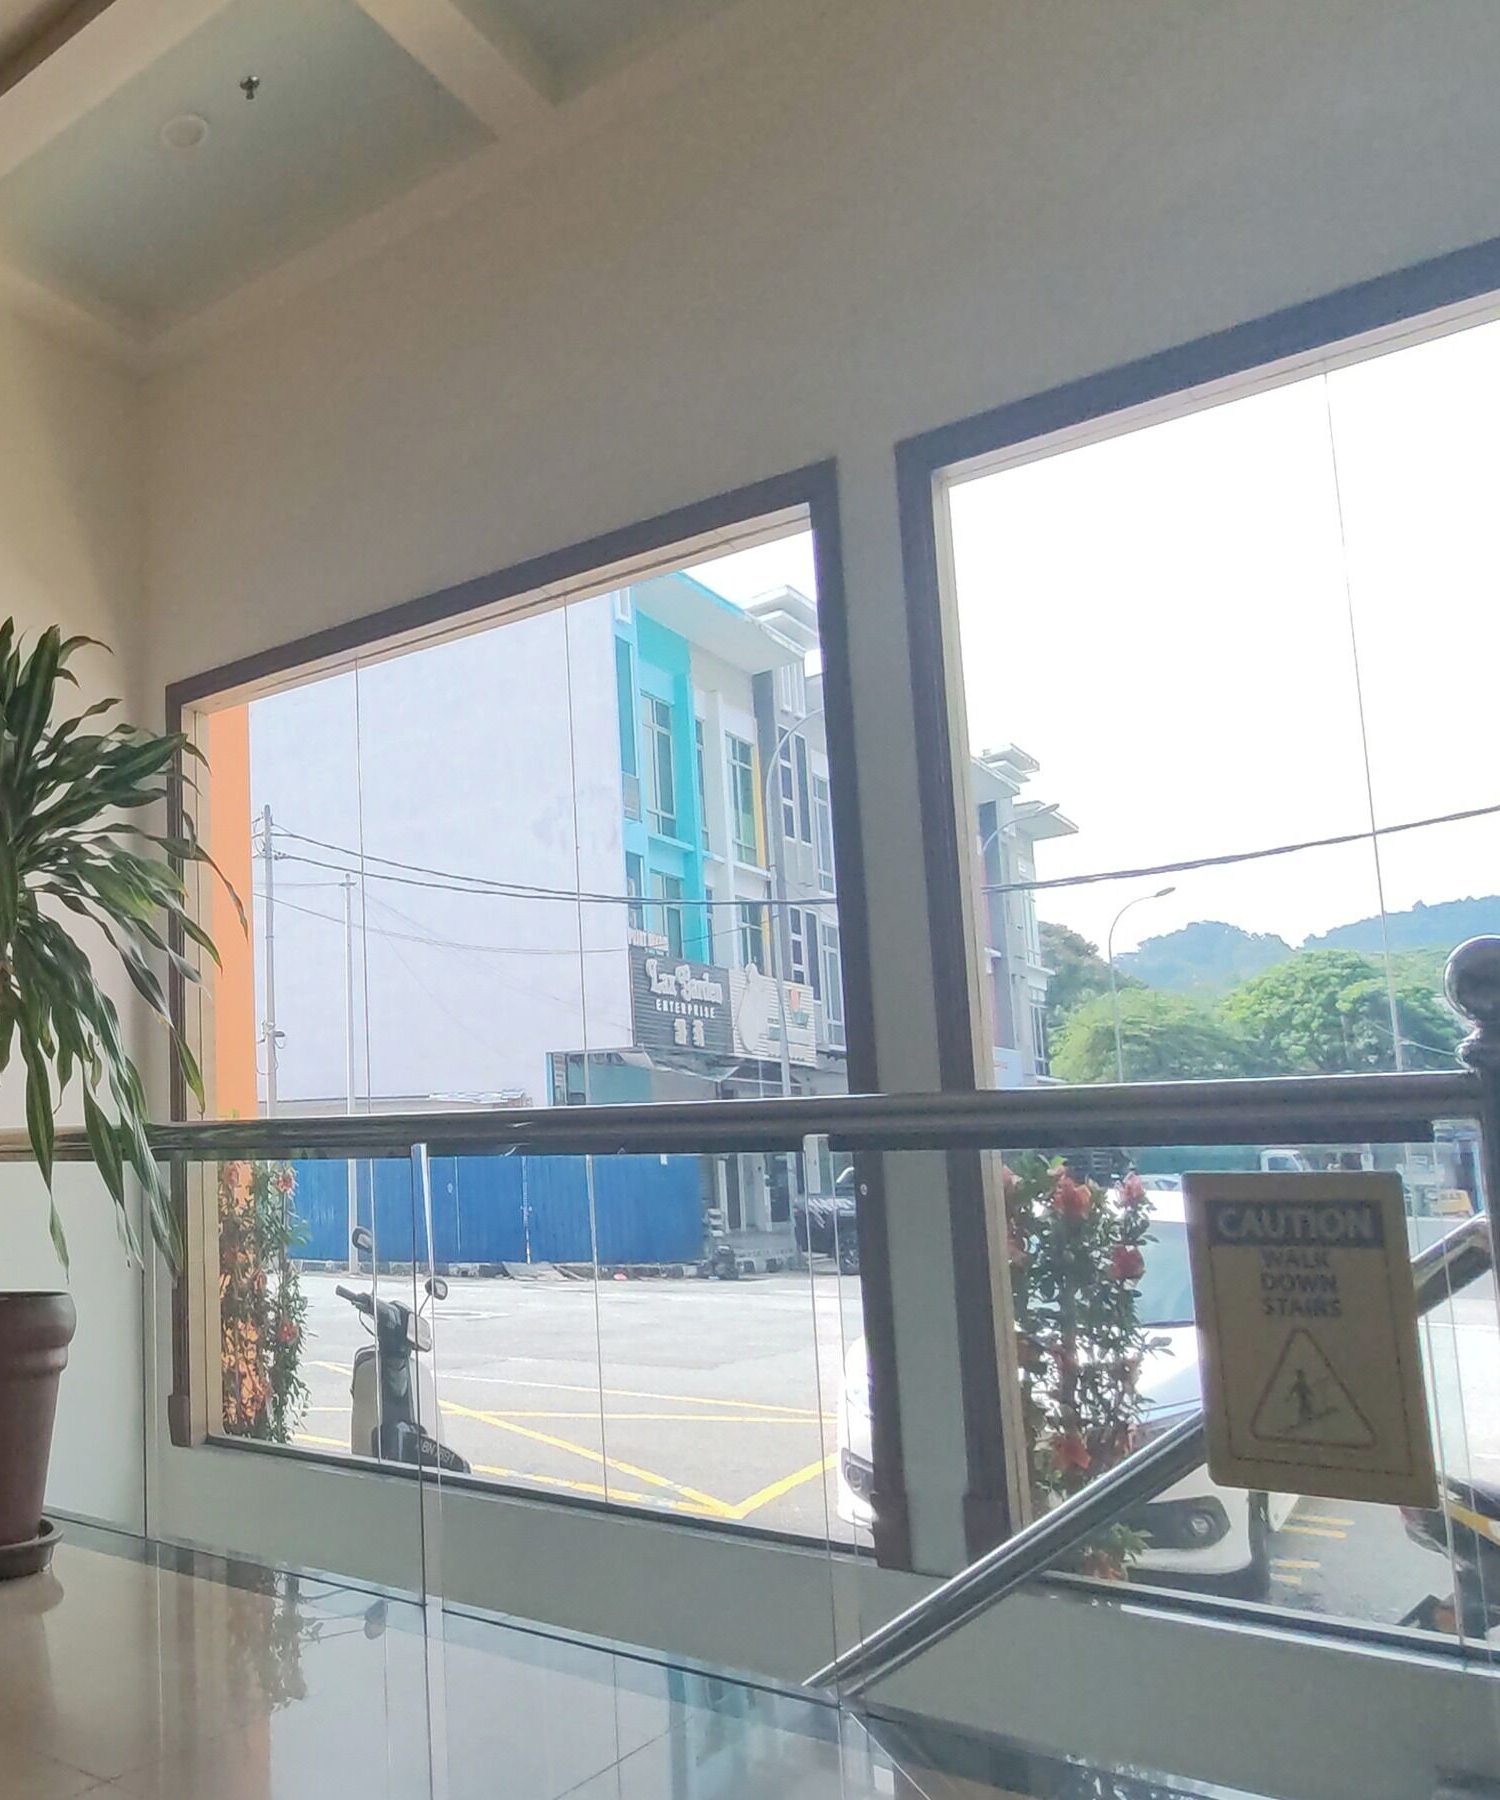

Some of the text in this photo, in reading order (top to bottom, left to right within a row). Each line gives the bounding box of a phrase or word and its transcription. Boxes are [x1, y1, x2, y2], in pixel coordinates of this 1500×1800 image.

[656, 999, 716, 1019] ENTERPRISE
[1217, 1206, 1374, 1240] CAUTION
[1261, 1250, 1329, 1269] WALK
[1261, 1273, 1337, 1292] DOWN
[1262, 1299, 1342, 1318] STAIRS
